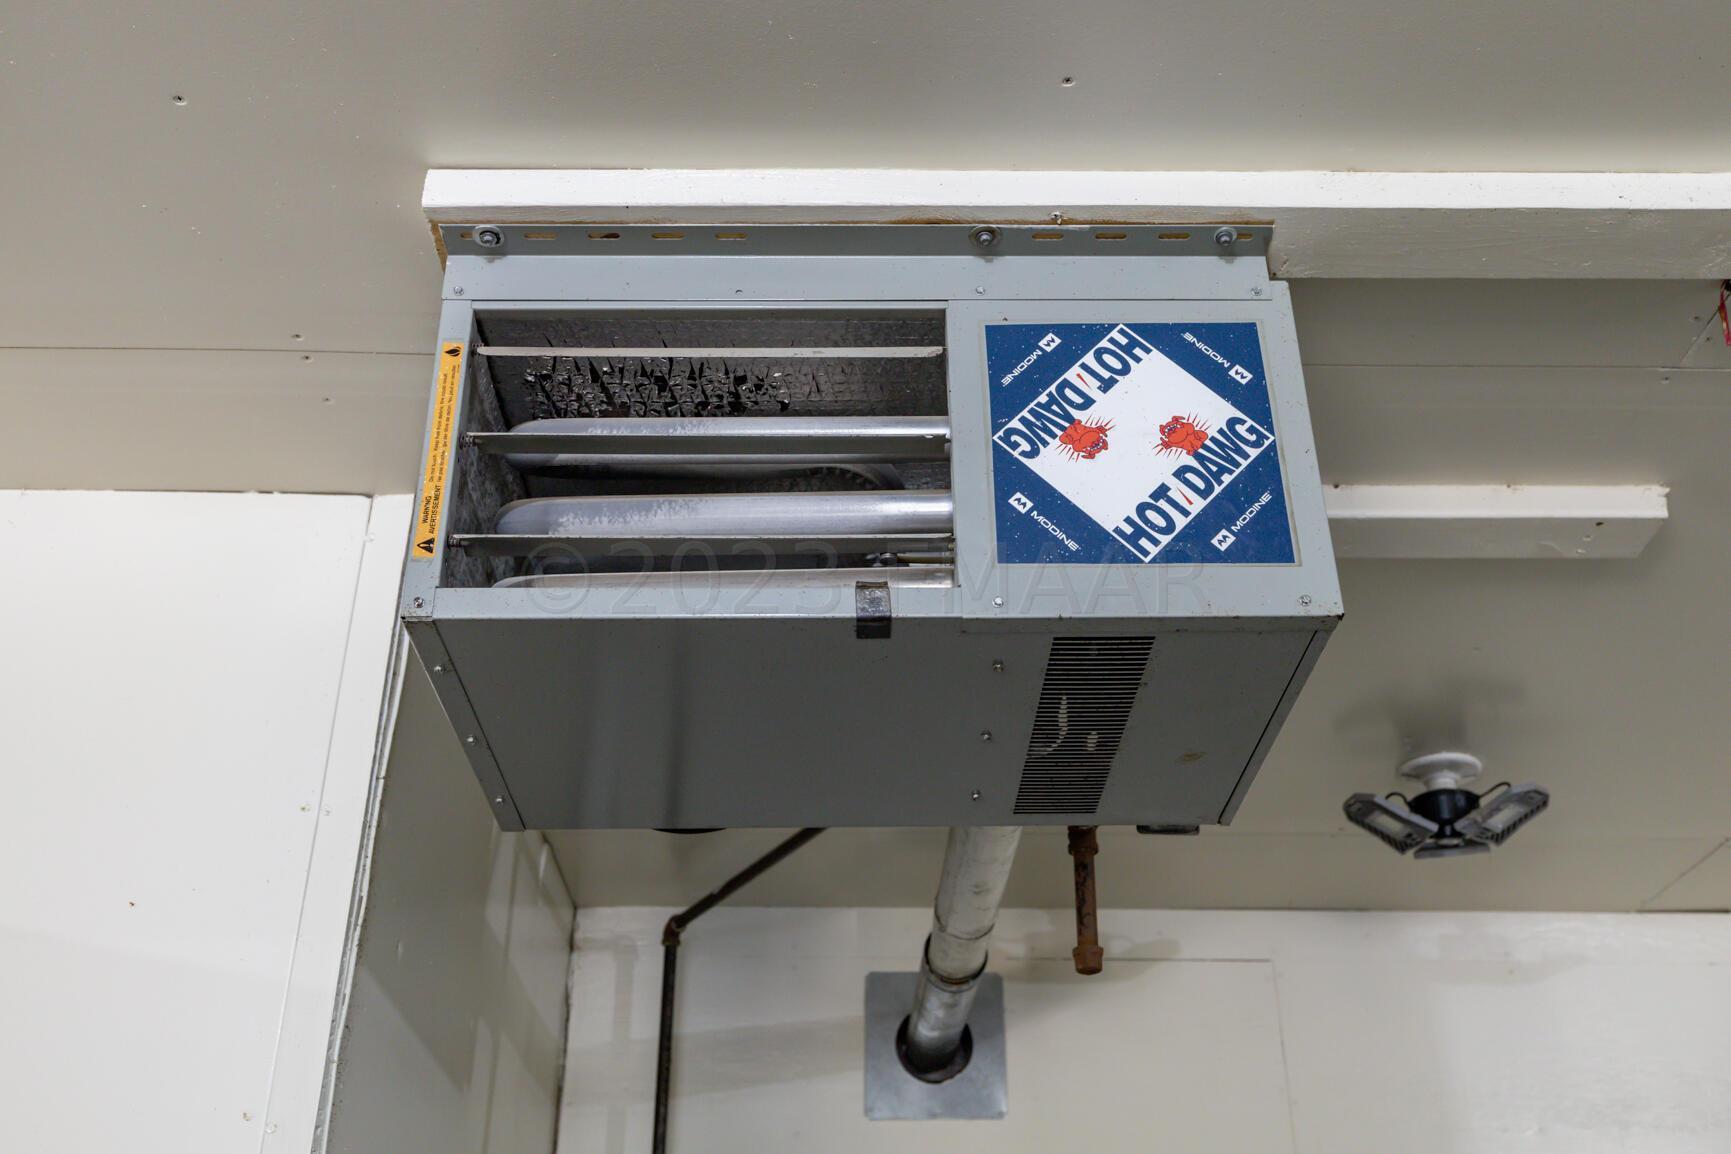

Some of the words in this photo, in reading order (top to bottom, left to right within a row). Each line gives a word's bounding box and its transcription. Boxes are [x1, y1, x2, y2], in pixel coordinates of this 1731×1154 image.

[1001, 349, 1043, 387] MODINE
[1078, 326, 1154, 394] HOT
[1183, 332, 1231, 368] MODINE
[997, 377, 1097, 460] DAWG
[428, 484, 441, 534] AVERTISSEMENT
[1112, 482, 1192, 559] HOT
[1171, 416, 1270, 501] DAWG
[1030, 510, 1080, 552] MODINE
[1231, 491, 1273, 533] MODINE
